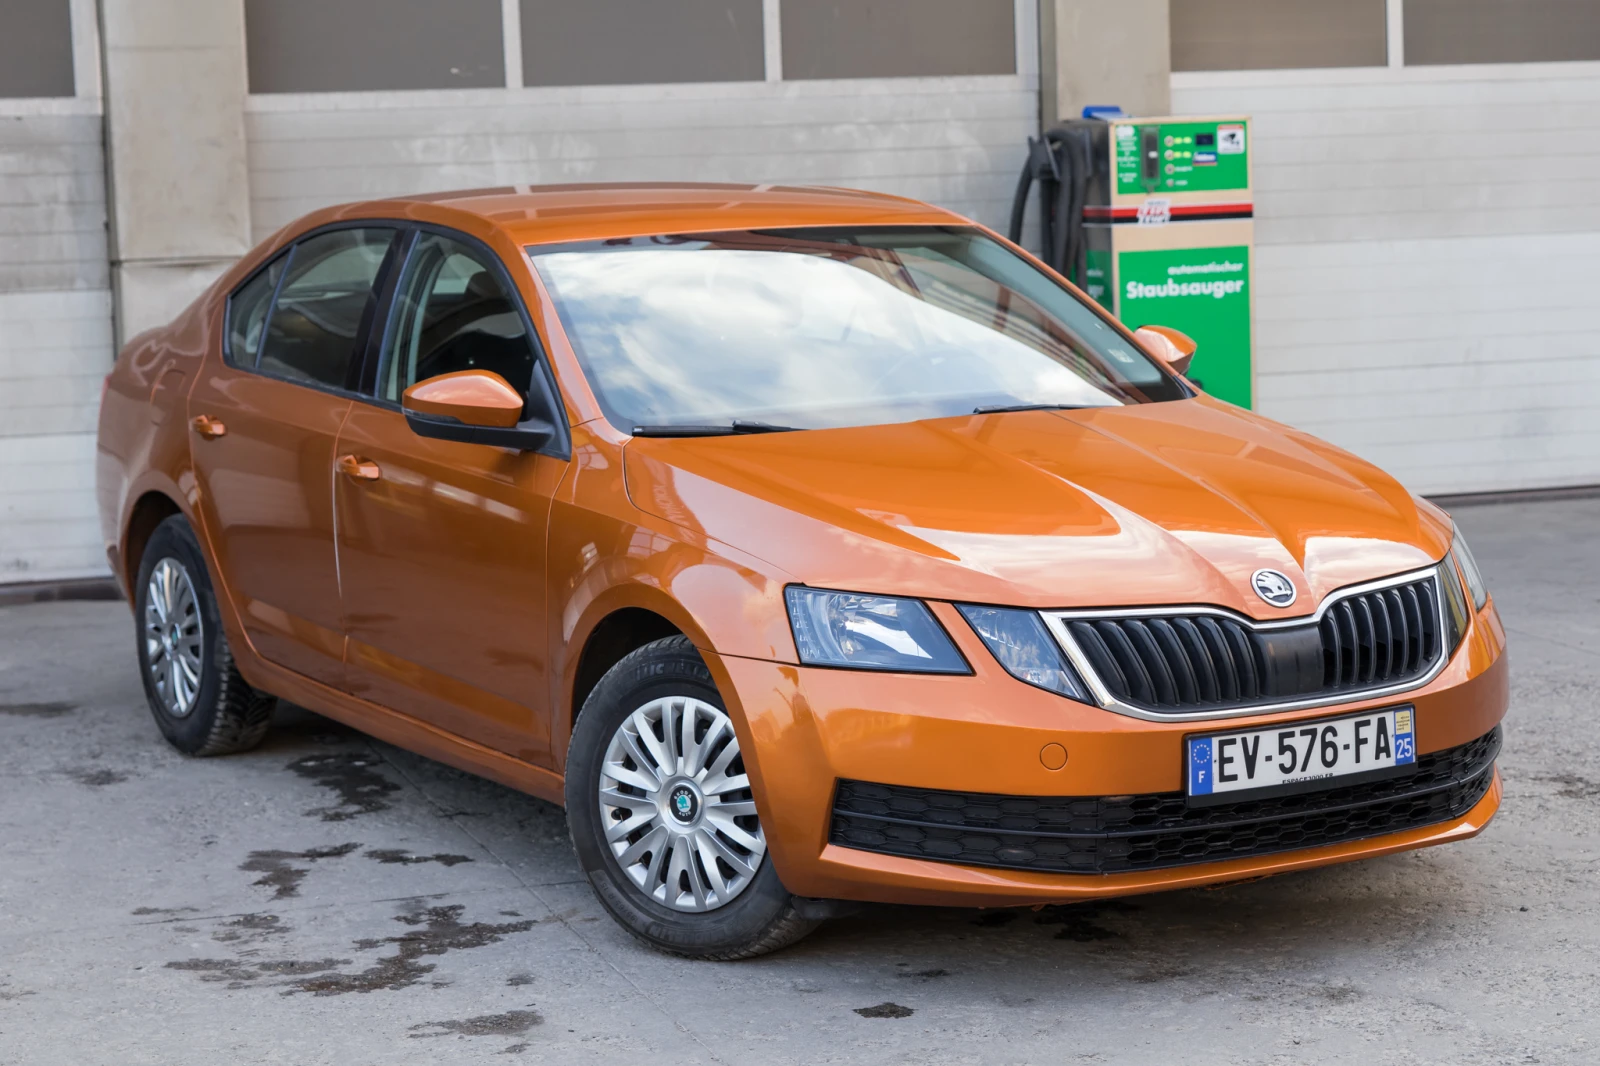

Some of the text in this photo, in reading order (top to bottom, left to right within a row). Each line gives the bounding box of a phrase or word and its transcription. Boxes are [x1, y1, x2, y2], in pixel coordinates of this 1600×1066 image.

[1167, 260, 1244, 276] automatischer
[1126, 277, 1245, 300] Staubsauger
[1218, 716, 1391, 783] EV-576-FA
[1396, 737, 1413, 760] 25
[1198, 770, 1206, 784] F
